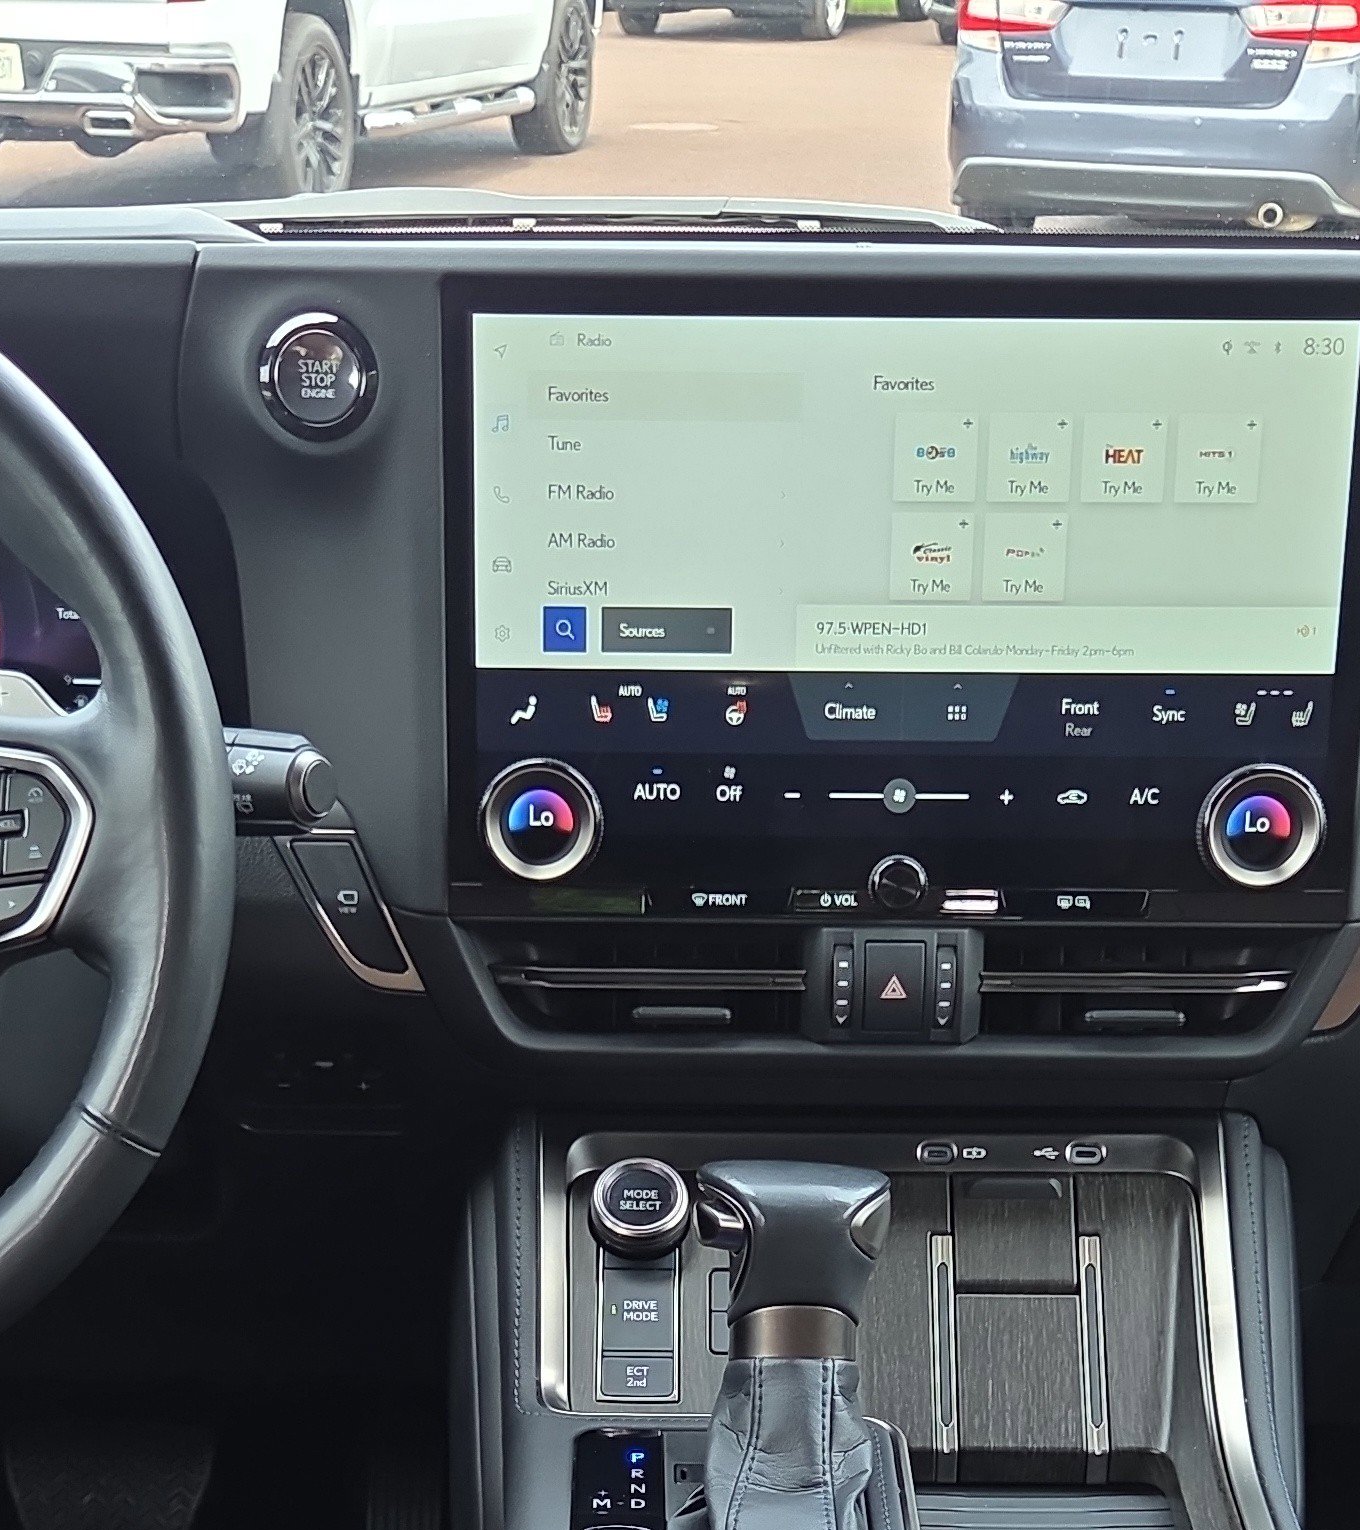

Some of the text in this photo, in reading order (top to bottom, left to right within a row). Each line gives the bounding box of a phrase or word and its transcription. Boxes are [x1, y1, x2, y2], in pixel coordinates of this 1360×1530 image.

[577, 333, 612, 347] Radio
[1303, 337, 1345, 356] 8:30
[298, 359, 340, 373] START
[301, 373, 336, 387] STOP
[873, 375, 935, 392] Favorites
[548, 385, 610, 402] Favorites
[548, 435, 582, 451] Tune
[1105, 449, 1144, 464] HEAT
[548, 484, 615, 500] FM Radio
[914, 479, 955, 496] Try Me
[1008, 480, 1049, 497] Try Me
[1102, 480, 1143, 498] Try Me
[1196, 480, 1237, 498] Try Me
[548, 533, 616, 549] AM Radio
[547, 580, 609, 597] SiriusXM
[910, 578, 951, 595] Try Me
[1003, 579, 1044, 596] Try Me
[619, 622, 667, 640] Sources
[618, 686, 642, 697] AUTO
[727, 686, 747, 696] AUTO
[824, 703, 877, 722] Climate
[1061, 698, 1100, 716] Front
[1152, 705, 1186, 724] Sync
[1065, 723, 1093, 738] Rear
[634, 783, 681, 801] AUTO
[716, 785, 743, 802] Off
[1129, 788, 1160, 806] A/C
[528, 804, 555, 828] Lo
[1244, 811, 1271, 833] Lo
[708, 893, 748, 907] FRONT
[833, 893, 858, 907] VOL
[623, 1189, 659, 1200] MODE
[619, 1201, 662, 1211] SELECT
[623, 1300, 658, 1310] DRIVE
[623, 1311, 659, 1322] MODE
[626, 1366, 649, 1377] ECT
[626, 1377, 647, 1387] 2nd
[631, 1452, 645, 1463] P
[631, 1468, 645, 1479] R
[631, 1483, 646, 1494] N
[592, 1498, 612, 1509] M
[630, 1498, 646, 1509] D
